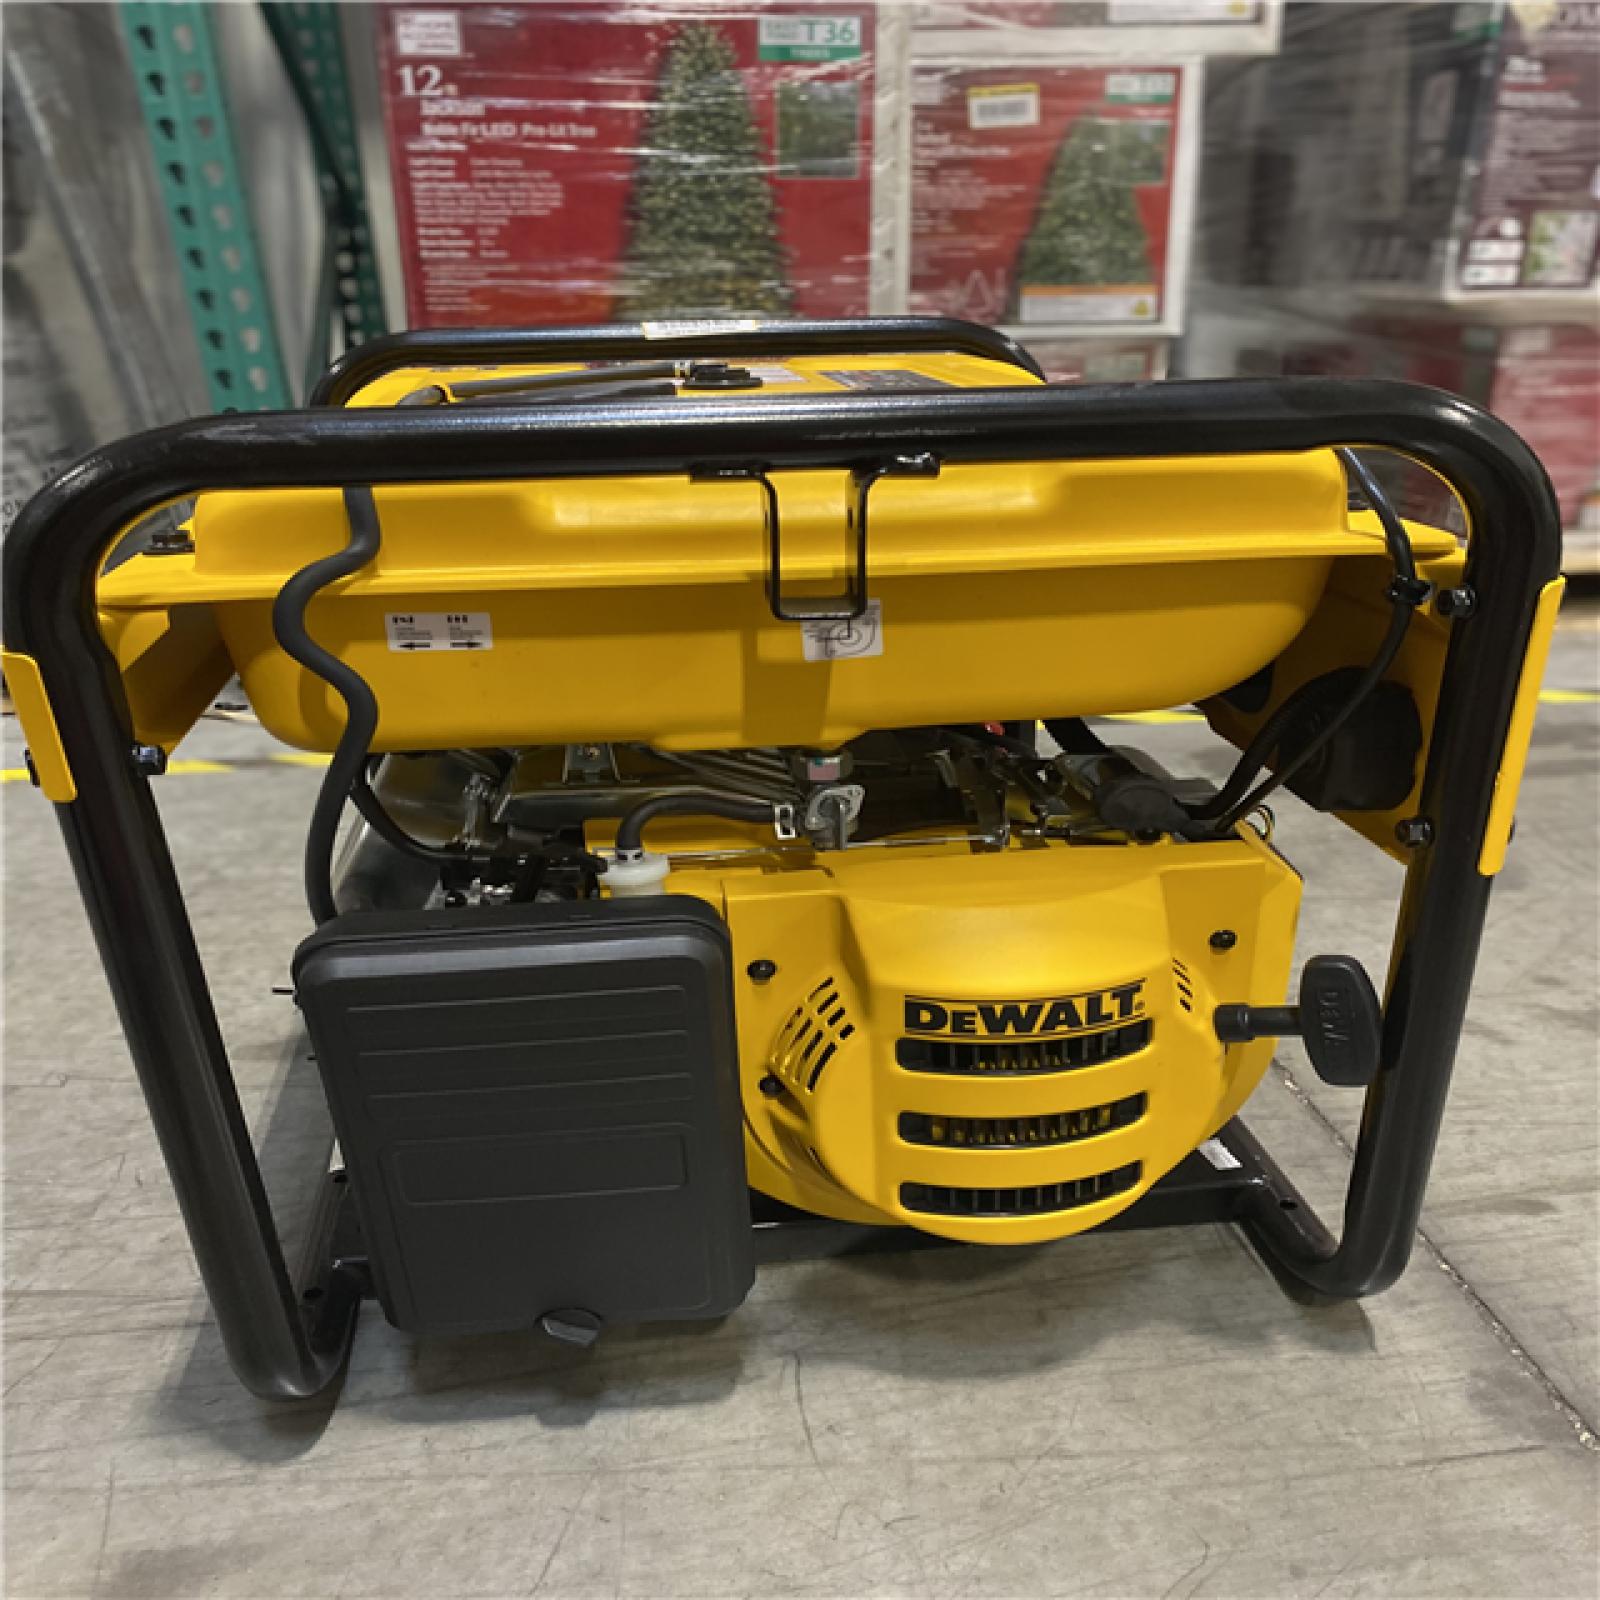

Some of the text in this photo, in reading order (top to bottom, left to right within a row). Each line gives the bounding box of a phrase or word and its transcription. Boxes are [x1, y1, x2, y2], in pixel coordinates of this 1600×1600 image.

[801, 20, 854, 43] T36
[399, 65, 442, 96] 12
[905, 979, 1142, 1034] DEWALT
